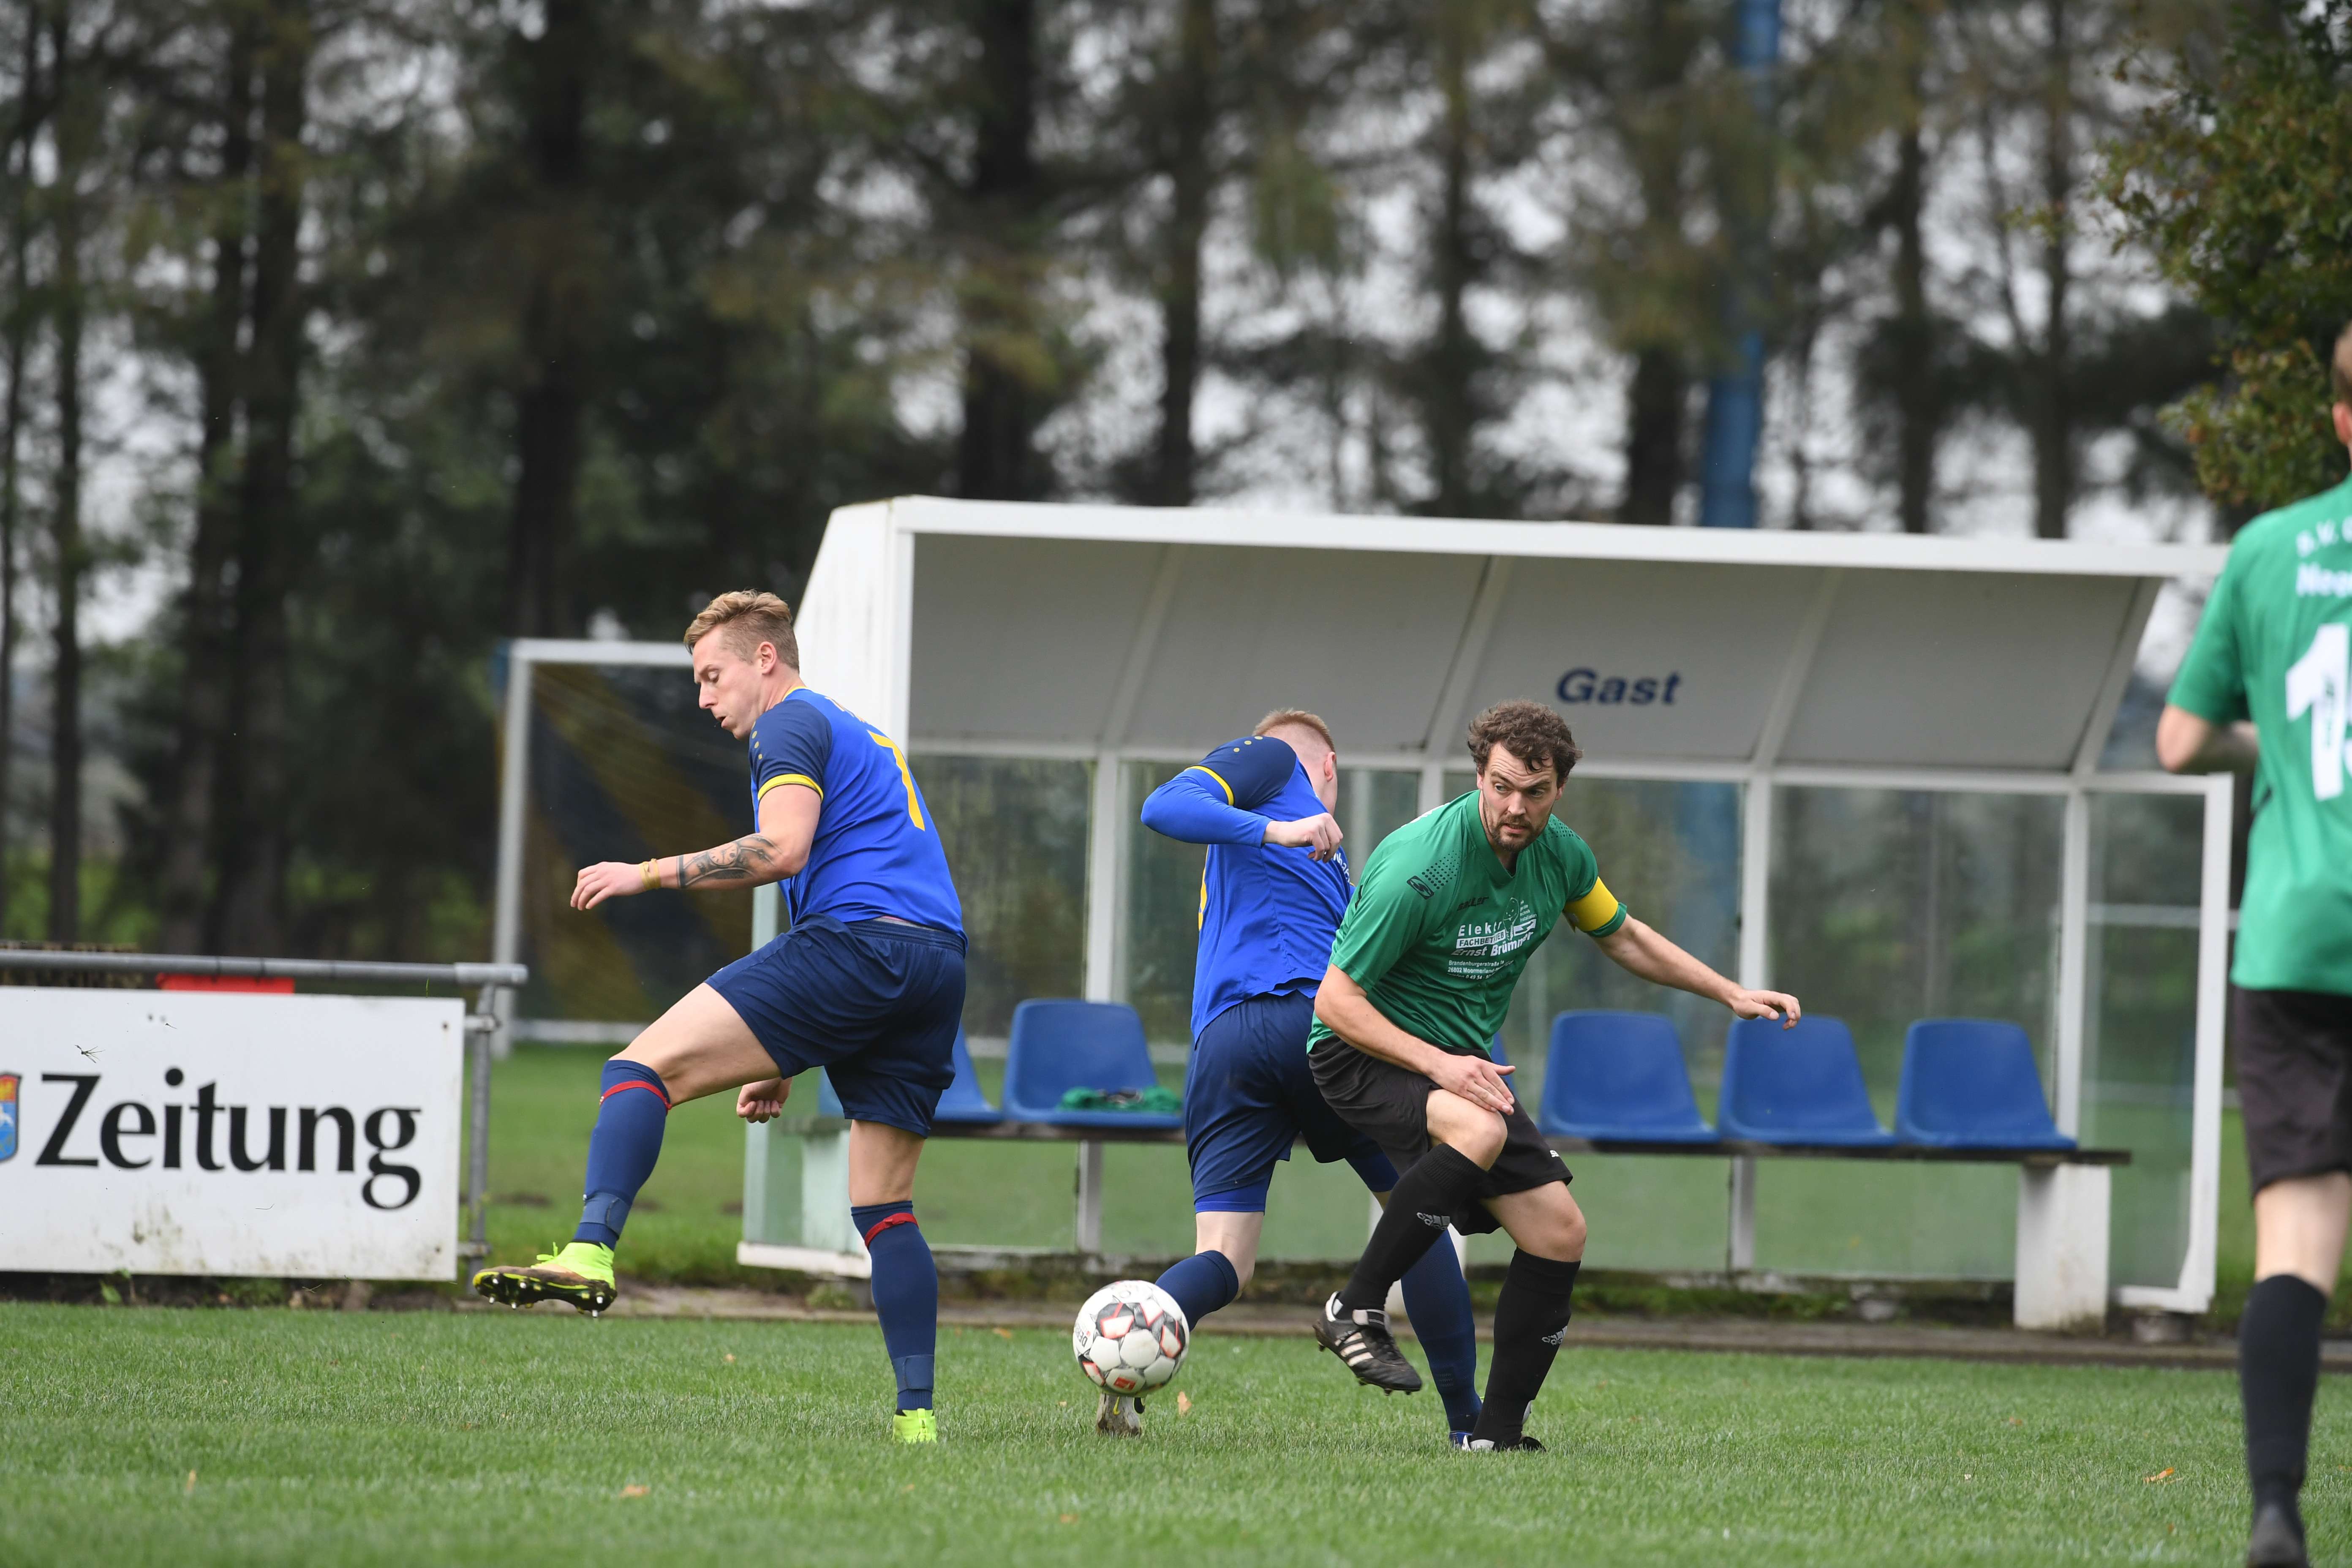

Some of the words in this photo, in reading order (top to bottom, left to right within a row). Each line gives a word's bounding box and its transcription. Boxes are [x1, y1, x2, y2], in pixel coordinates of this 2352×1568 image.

[1556, 667, 1682, 705] Gast
[1451, 946, 1487, 956] Ernst
[34, 1067, 422, 1211] Zeitung
